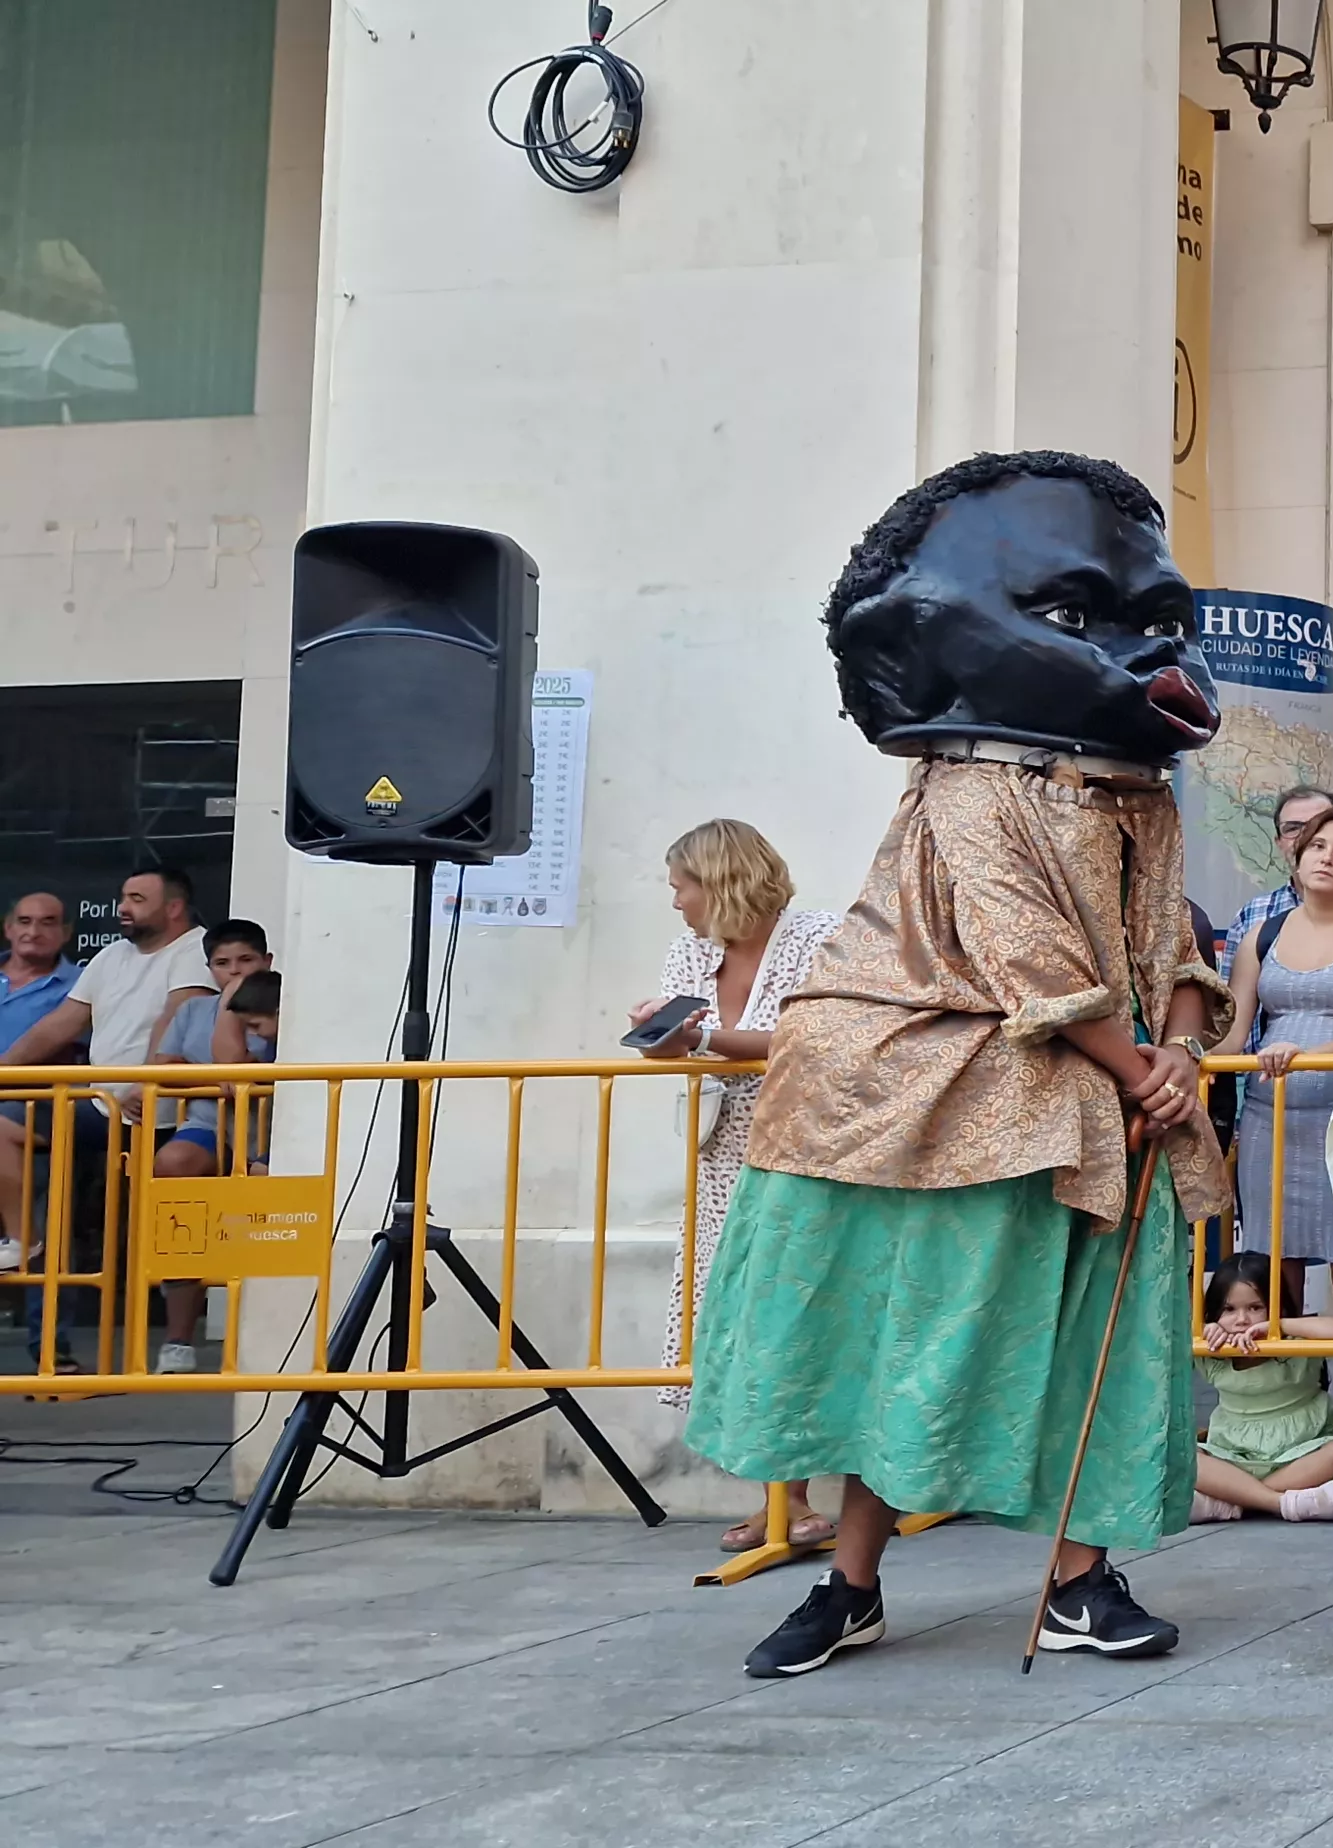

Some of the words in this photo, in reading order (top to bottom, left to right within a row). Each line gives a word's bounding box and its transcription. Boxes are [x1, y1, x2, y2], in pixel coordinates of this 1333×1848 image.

[1177, 195, 1203, 226] de
[1201, 639, 1262, 656] CIUDAD
[1267, 644, 1287, 660] DE
[1290, 647, 1333, 669] LEYENDA
[1216, 662, 1250, 673] RUTAS
[1251, 665, 1265, 675] DE
[1275, 667, 1291, 677] DÍA
[79, 900, 109, 918] Por
[248, 1229, 298, 1241] uesca
